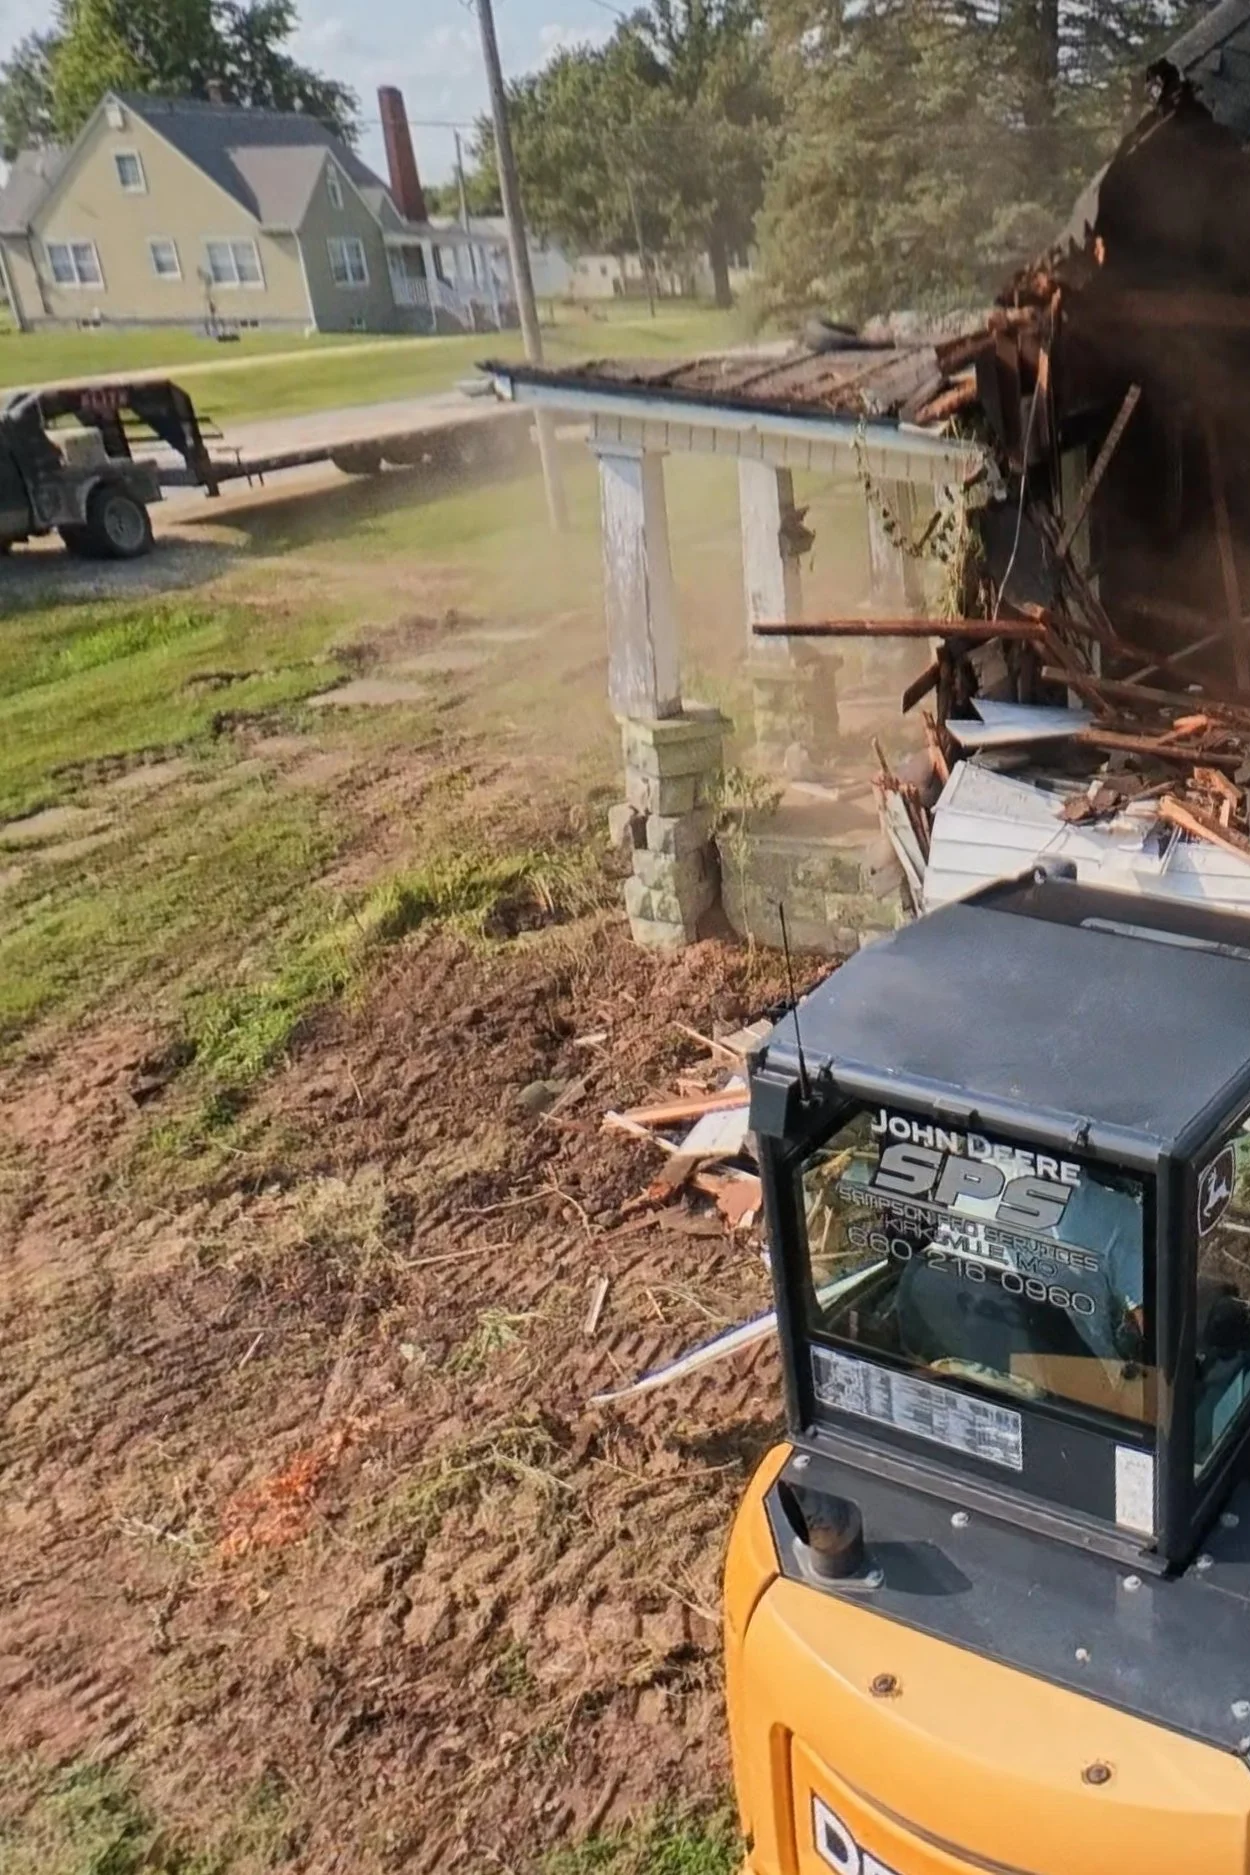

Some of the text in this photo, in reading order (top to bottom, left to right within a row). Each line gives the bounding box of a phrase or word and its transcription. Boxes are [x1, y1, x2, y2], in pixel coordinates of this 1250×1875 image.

[870, 1108, 1081, 1187] JOHN DEERE
[873, 1141, 1074, 1231] SPS
[838, 1185, 1100, 1273] SAMPSON PRO SERVICES
[1016, 1250, 1059, 1278] MO
[811, 1794, 898, 1875] D
